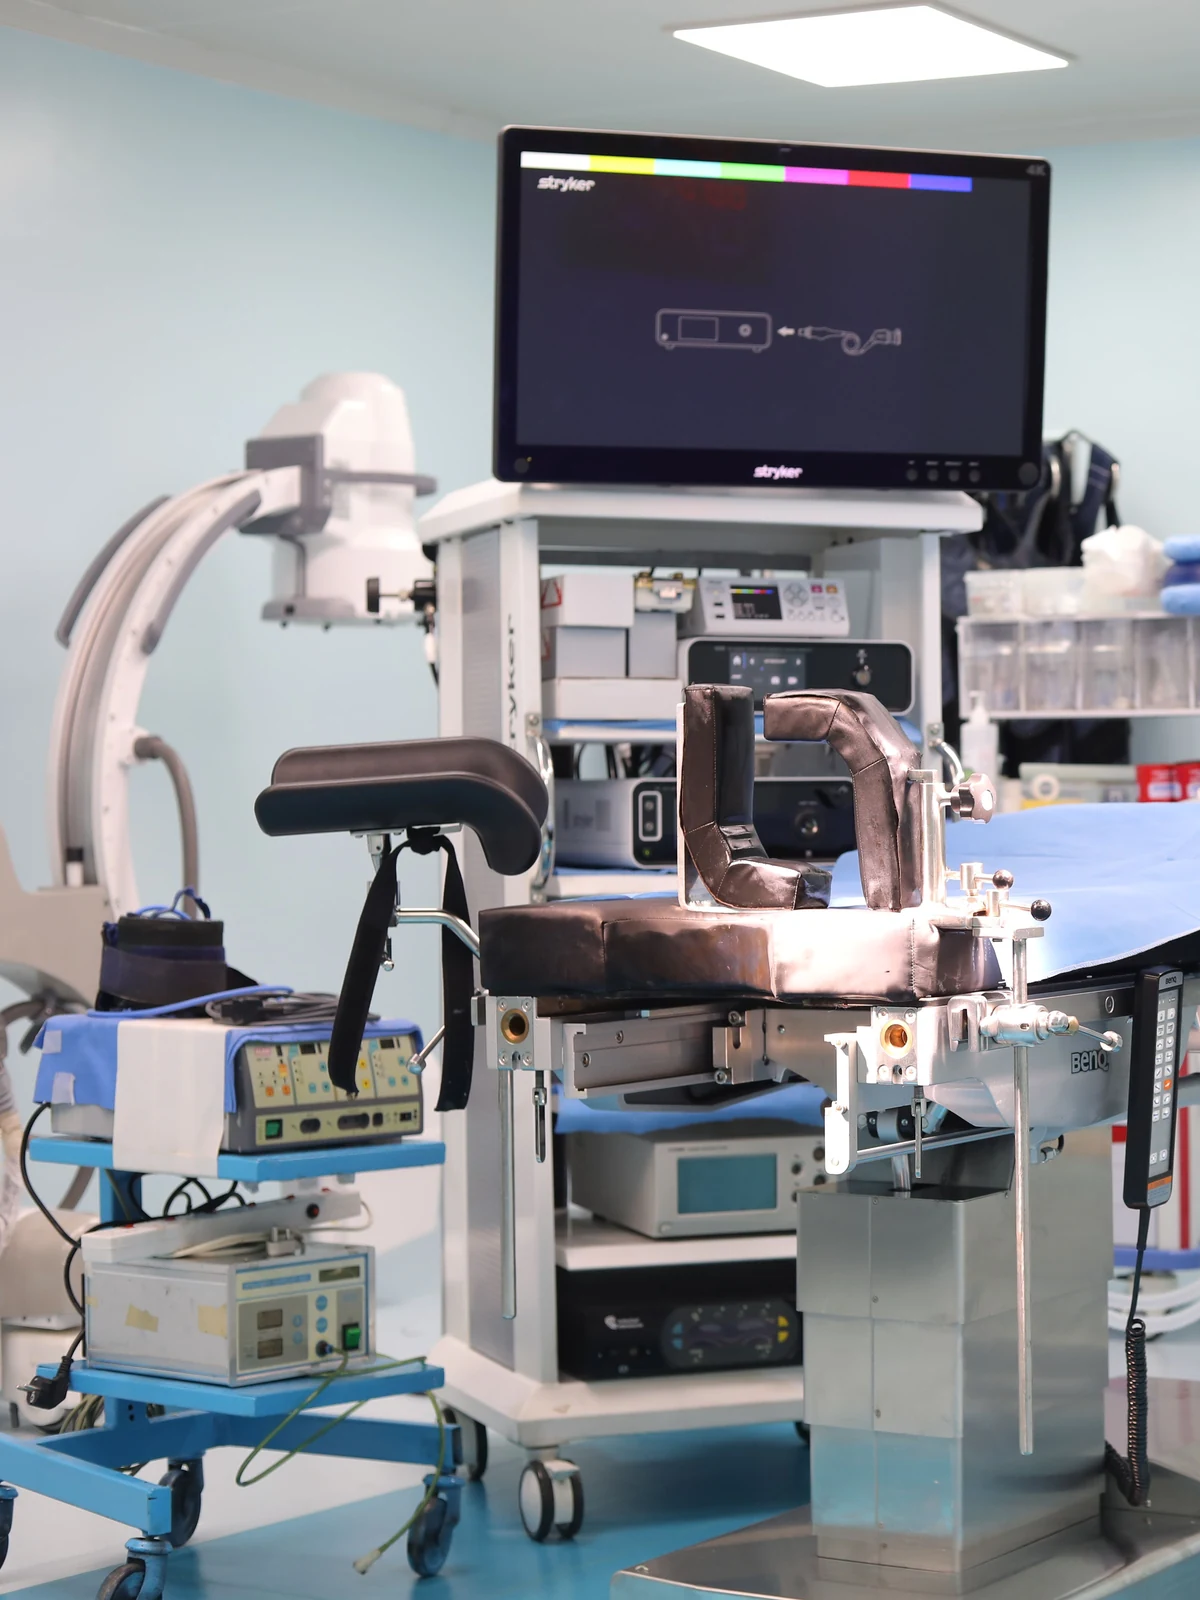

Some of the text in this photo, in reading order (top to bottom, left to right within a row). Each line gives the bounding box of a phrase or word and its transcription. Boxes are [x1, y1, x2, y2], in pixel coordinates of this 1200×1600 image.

[537, 175, 596, 192] stryker
[753, 464, 804, 480] stryker
[1071, 1050, 1109, 1074] BenQ
